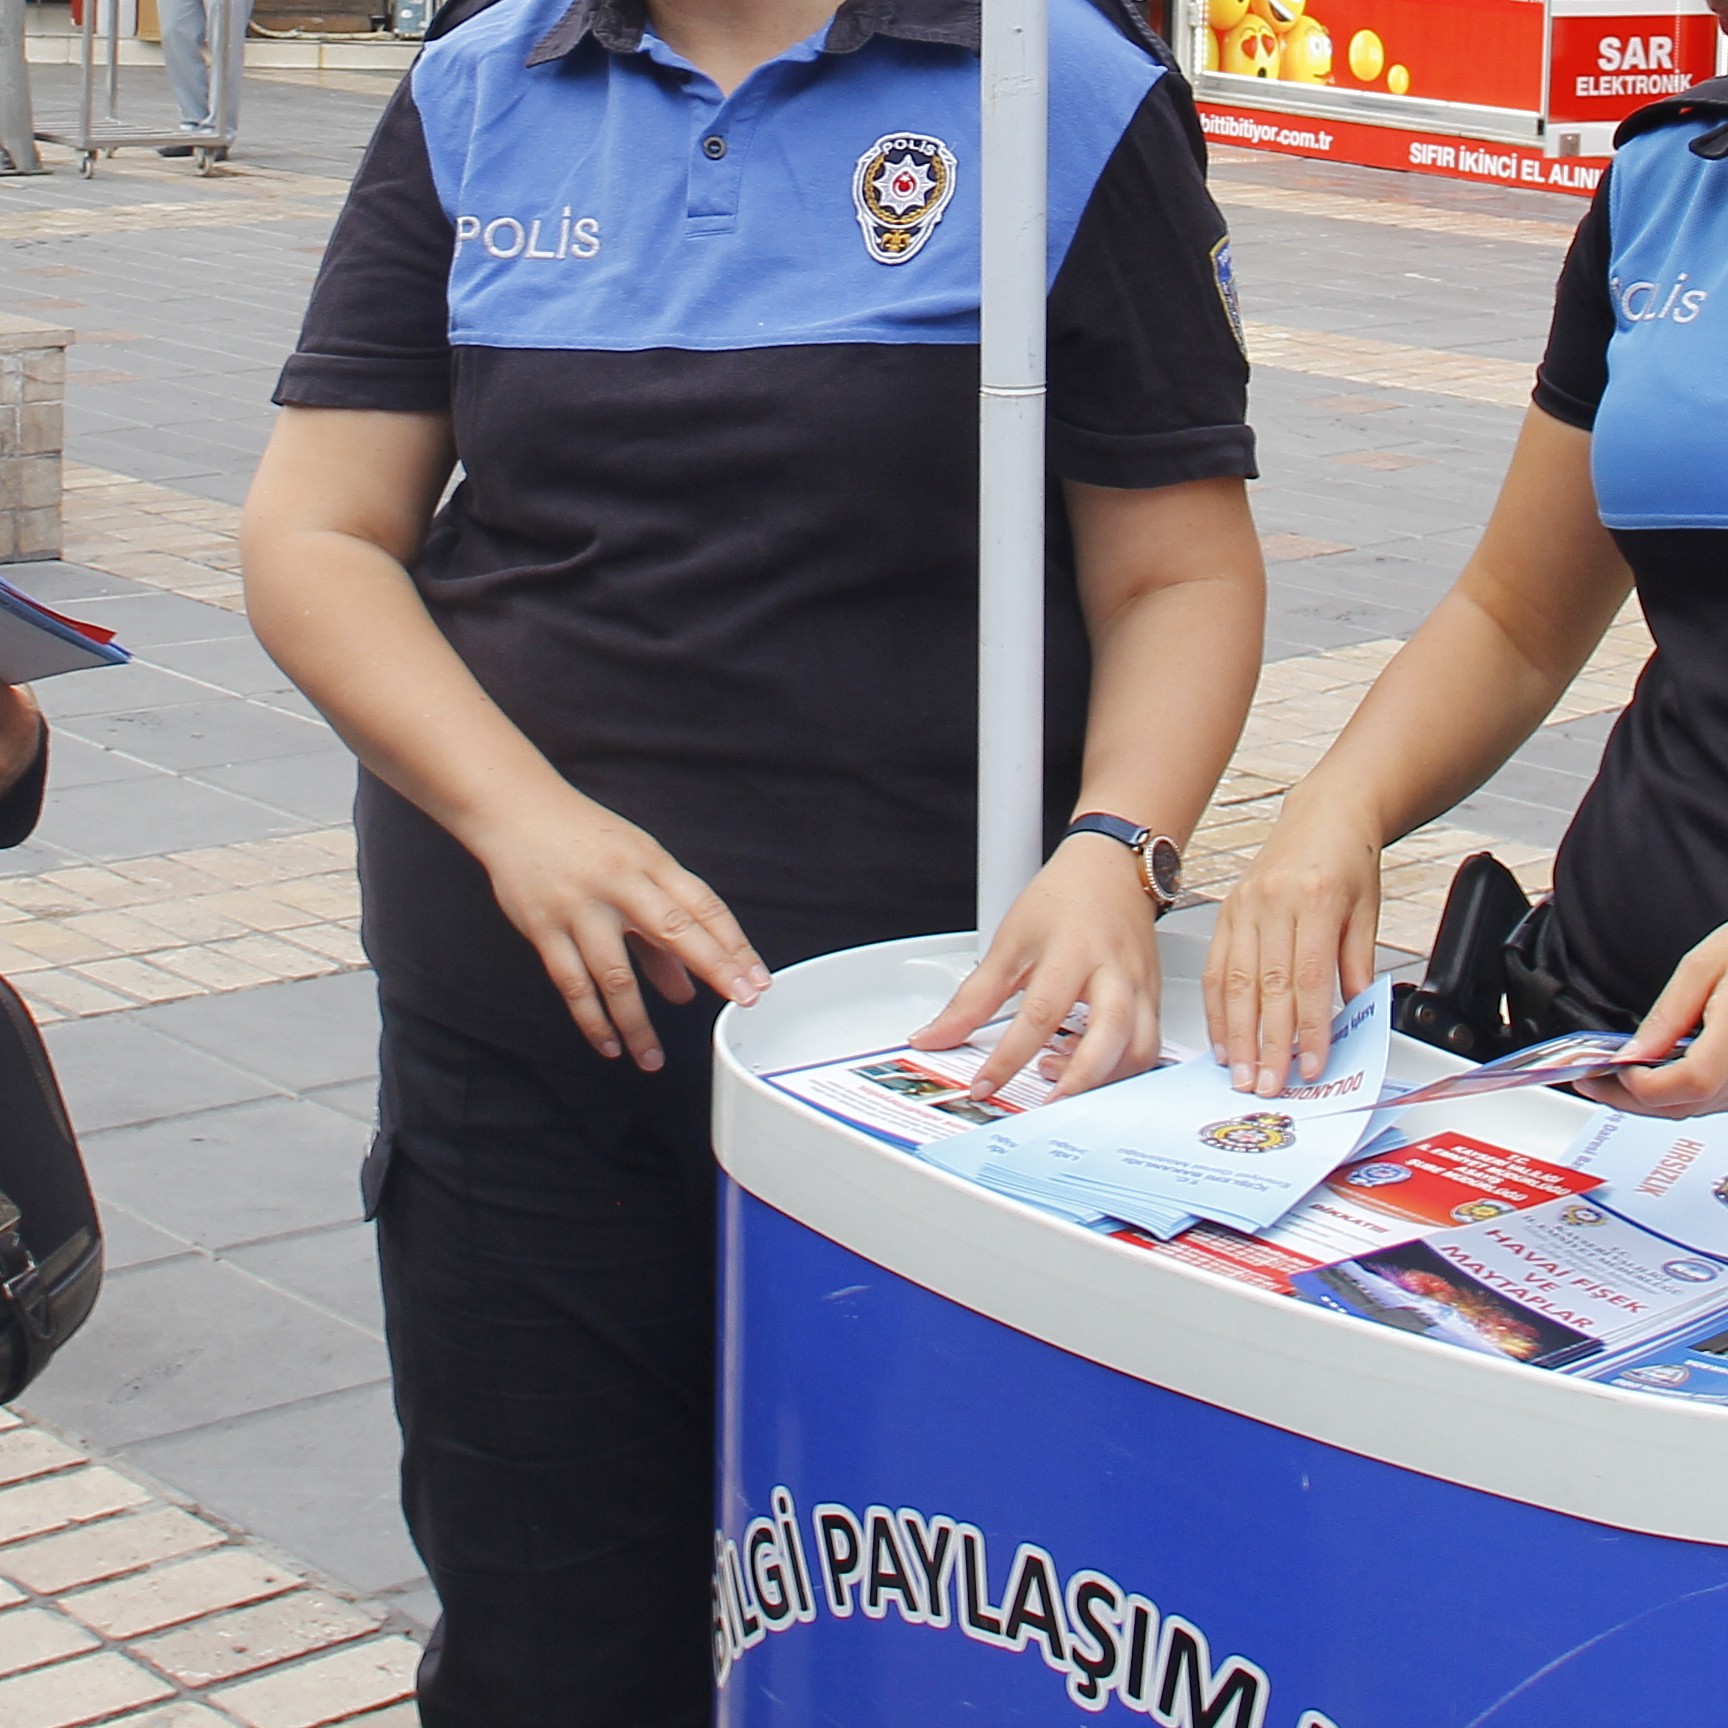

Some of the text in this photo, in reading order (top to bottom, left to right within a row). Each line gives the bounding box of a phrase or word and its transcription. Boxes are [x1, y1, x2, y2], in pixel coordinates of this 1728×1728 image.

[1597, 35, 1673, 72] SAR
[882, 137, 940, 158] POLİS
[1408, 141, 1455, 168] SIFIR
[1458, 145, 1518, 180] İKİNCİ
[1521, 159, 1545, 183] EL
[456, 205, 601, 261] POLİS
[1633, 1136, 1704, 1199] HIRSIZLIK
[1442, 1244, 1598, 1330] MAYTAPLAR
[1524, 1273, 1562, 1293] VE
